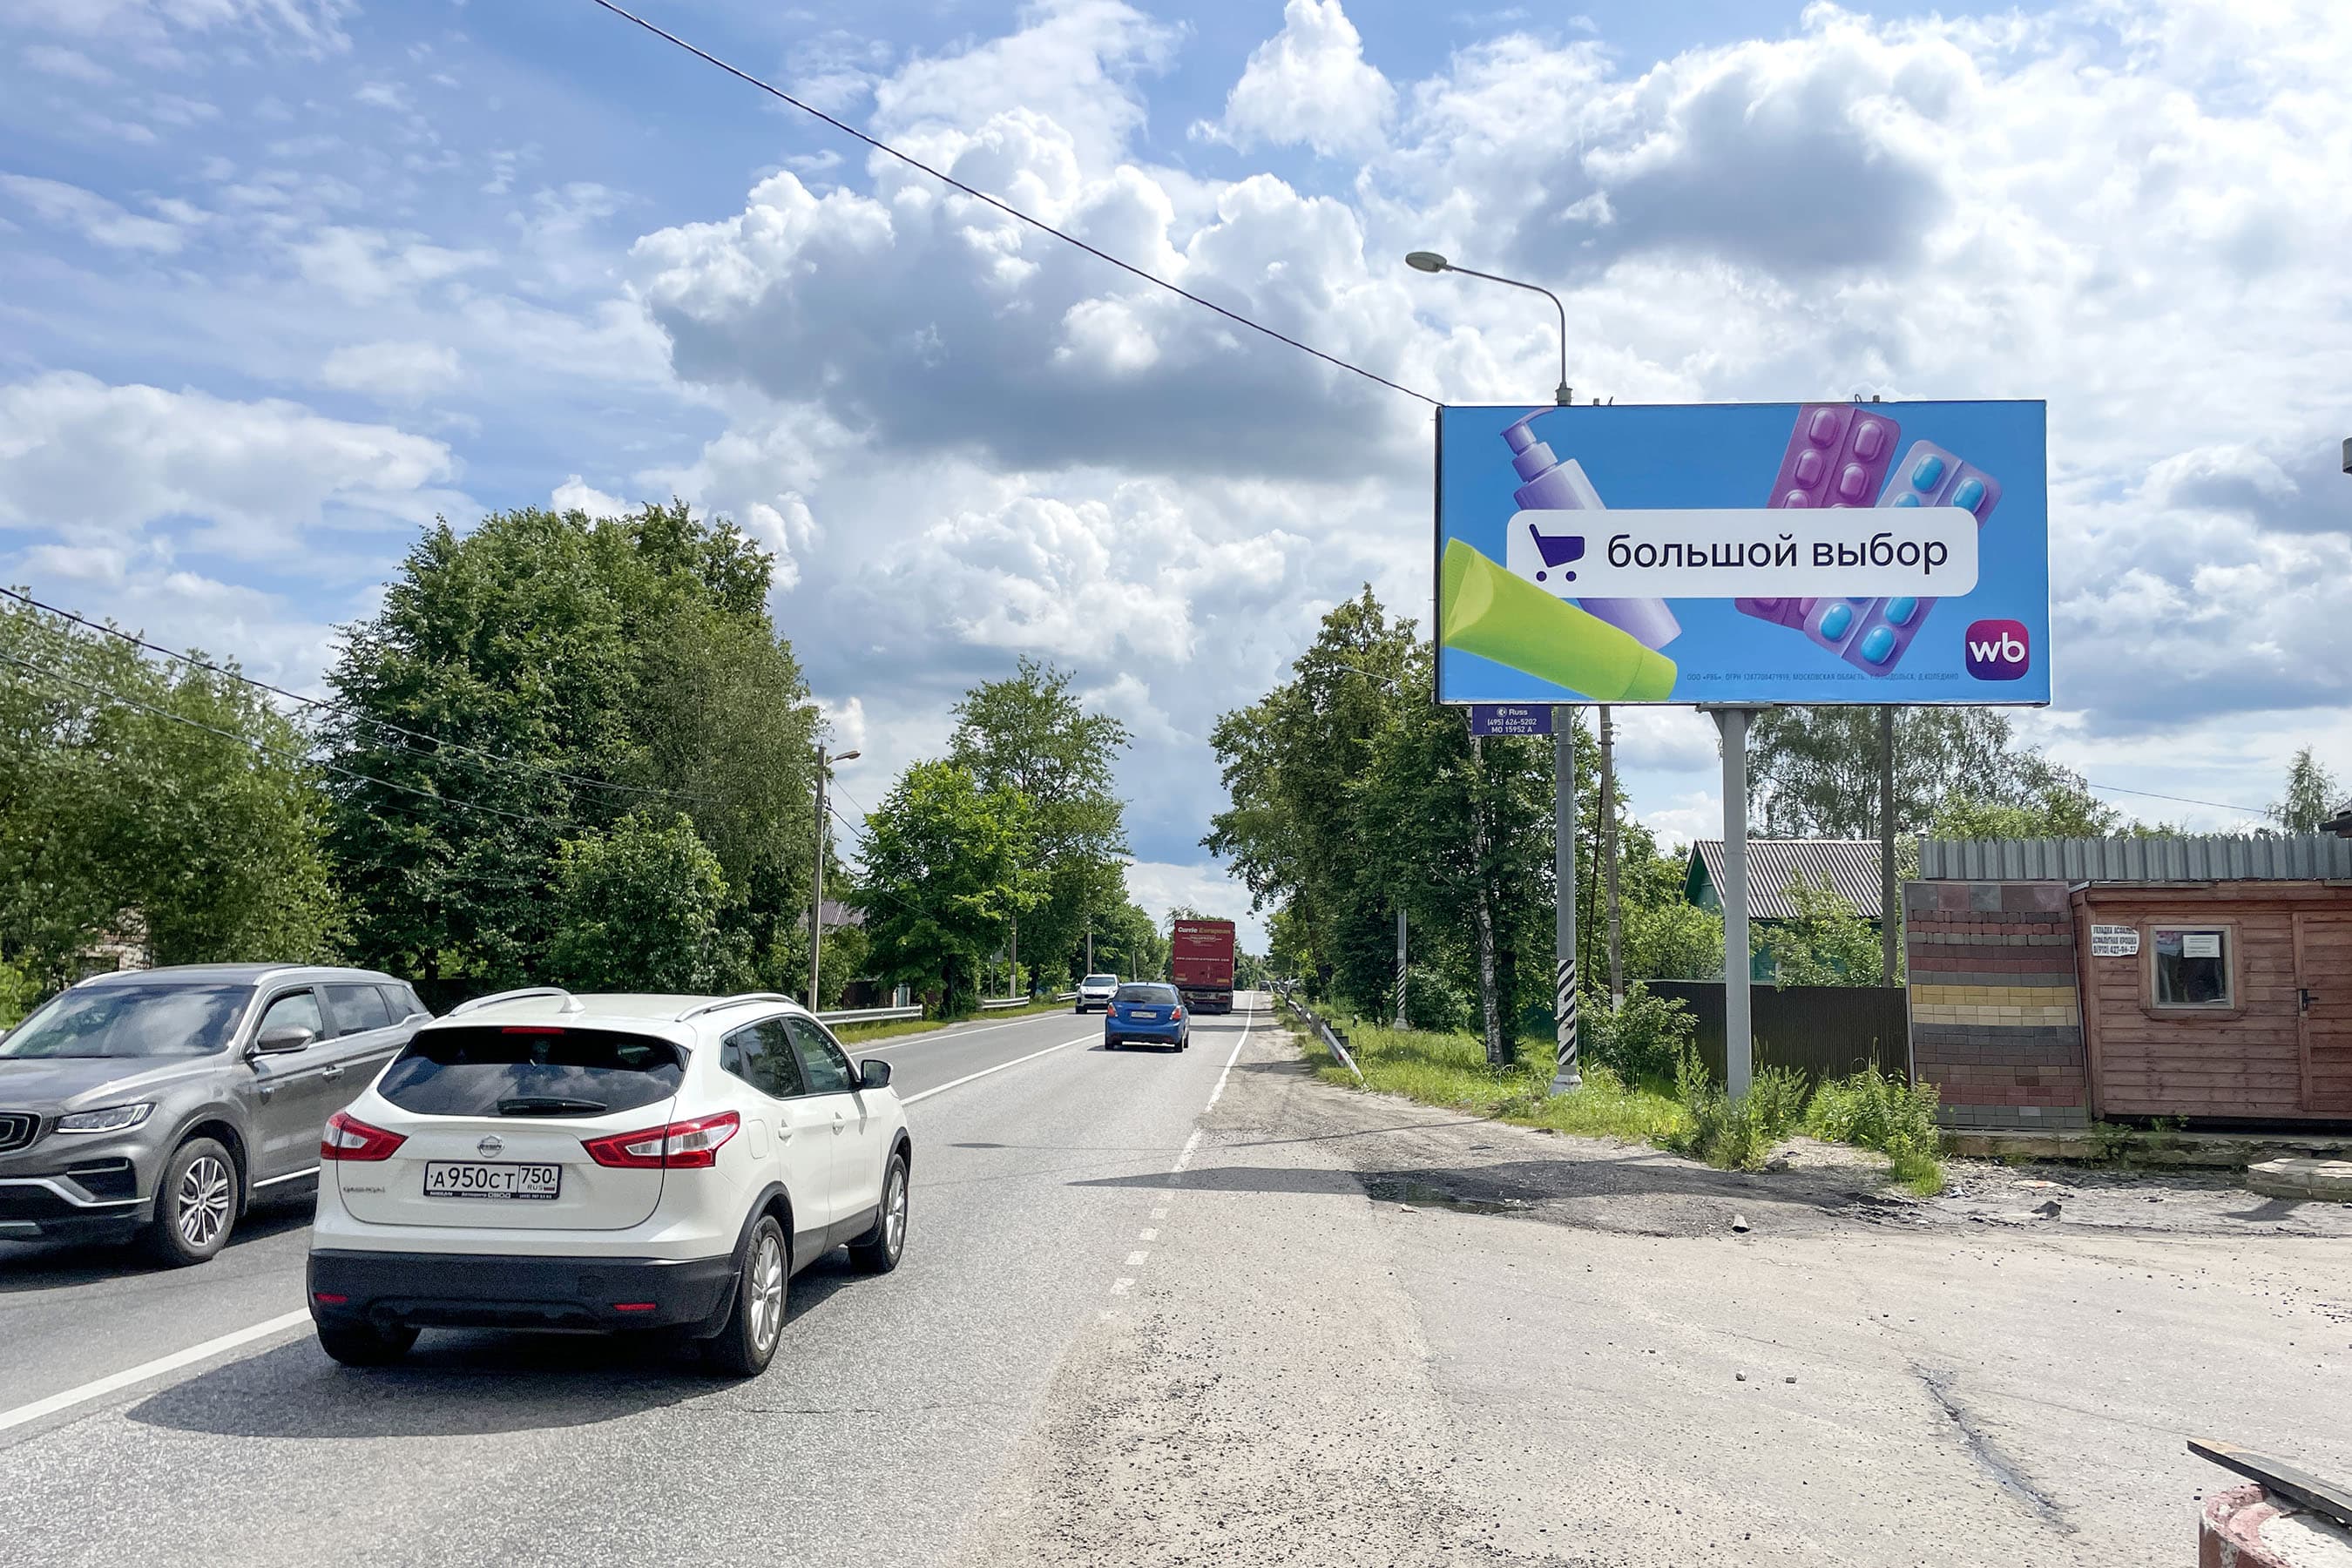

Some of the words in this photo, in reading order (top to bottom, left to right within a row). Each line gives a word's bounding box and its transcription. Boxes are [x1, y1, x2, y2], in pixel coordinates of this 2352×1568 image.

[1607, 532, 1798, 569] большой
[1813, 532, 1949, 575] выбор
[1969, 632, 2026, 663] wb
[1487, 718, 1504, 727] (495)
[433, 1167, 516, 1189] А950СТ
[521, 1167, 553, 1184] 750
